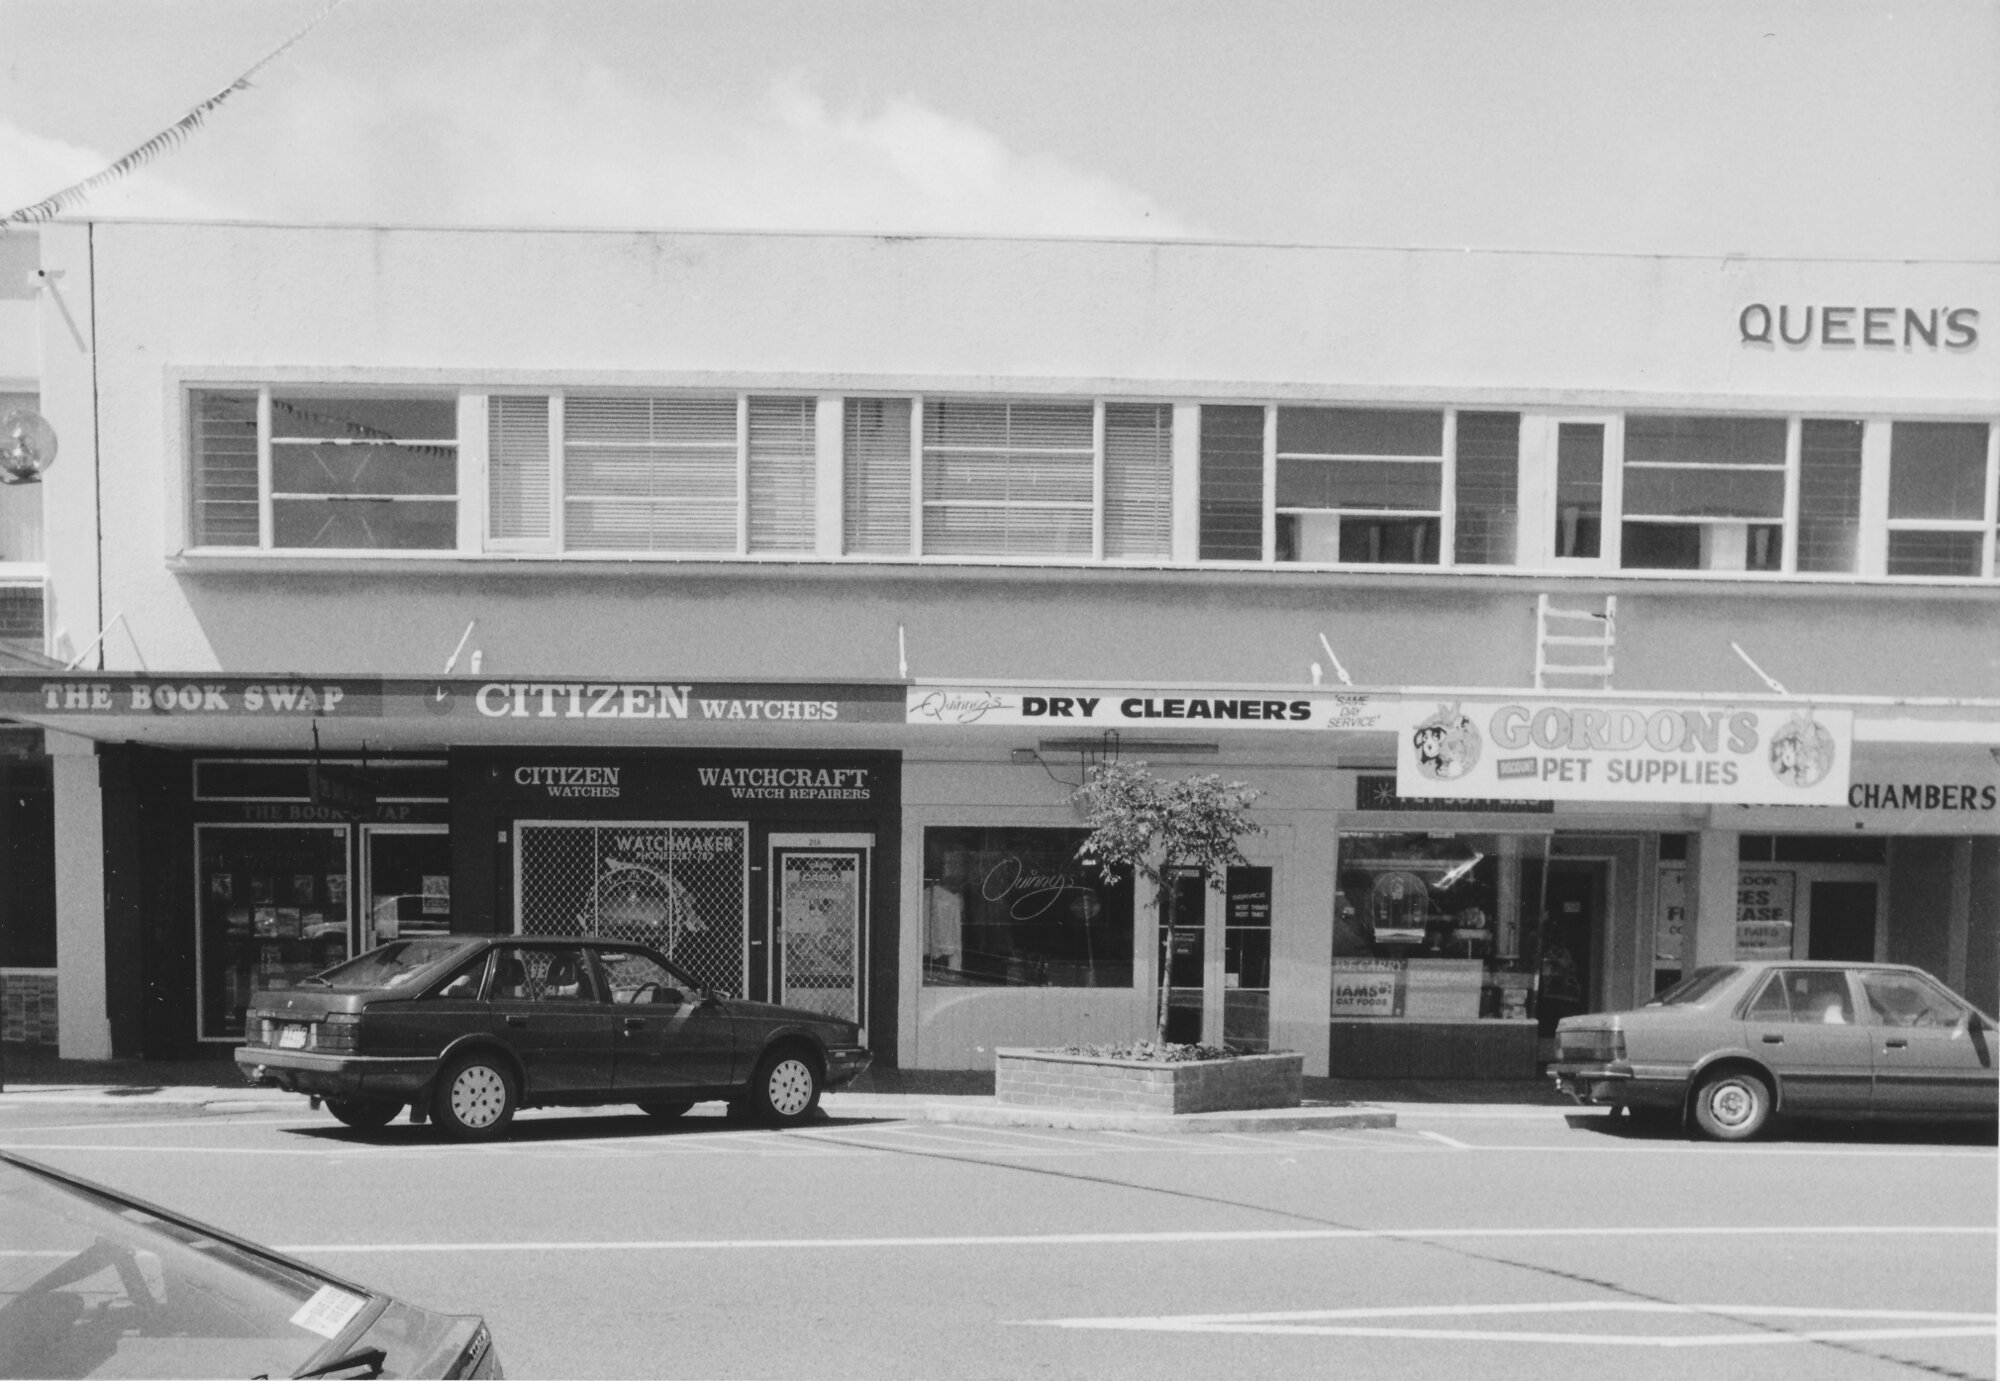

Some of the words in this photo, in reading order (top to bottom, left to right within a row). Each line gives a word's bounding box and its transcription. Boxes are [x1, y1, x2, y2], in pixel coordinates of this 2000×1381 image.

[1739, 303, 1979, 347] QUEEN'S
[42, 684, 113, 711] THE
[130, 684, 230, 711] BOOK
[244, 685, 344, 712] SWAP
[475, 682, 693, 720] CITIZEN
[700, 700, 839, 721] WATCHES
[1022, 696, 1100, 718] DRY
[1119, 698, 1312, 721] CLEANERS
[1340, 706, 1361, 717] DAY
[1489, 705, 1760, 754] GORDON'S
[514, 767, 620, 785] CITIZEN
[698, 768, 868, 787] WATCHCRAFT
[1542, 757, 1592, 782] PET
[1606, 758, 1739, 785] SUPPLIES
[547, 786, 620, 797] WATCHES
[731, 788, 783, 799] WATCH
[789, 789, 870, 799] REPAIRERS
[1848, 783, 1998, 810] CHAMBERS
[243, 806, 281, 819] THE
[616, 836, 733, 852] WATCHMAKER
[636, 851, 669, 860] PHONE
[1336, 984, 1378, 998] IAMS
